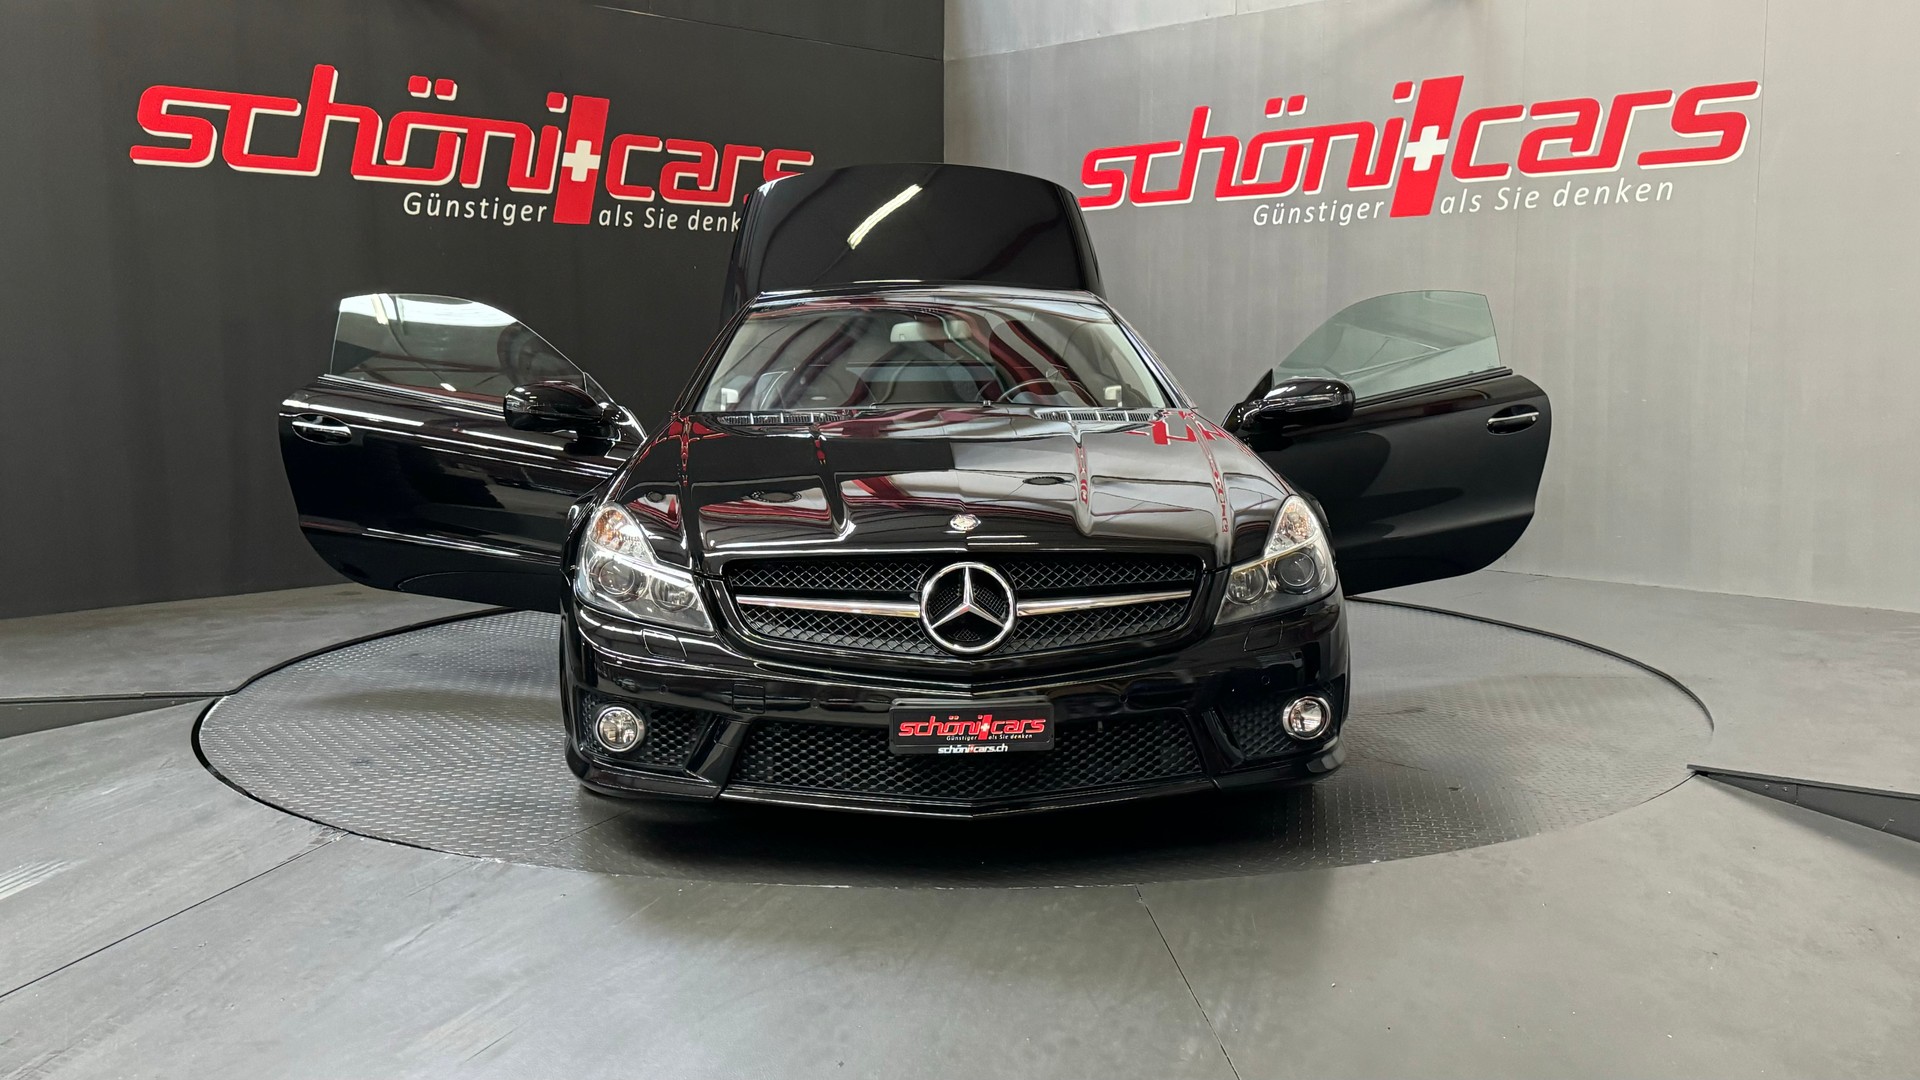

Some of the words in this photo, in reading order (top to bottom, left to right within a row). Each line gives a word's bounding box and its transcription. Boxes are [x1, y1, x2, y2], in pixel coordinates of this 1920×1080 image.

[402, 190, 548, 226] Günstiger
[598, 203, 634, 230] als
[643, 204, 679, 232] Sie
[687, 207, 741, 233] denk
[1252, 200, 1384, 228] Günstiger
[1440, 190, 1482, 216] als
[1494, 186, 1539, 212] Sie
[1552, 178, 1674, 207] denken
